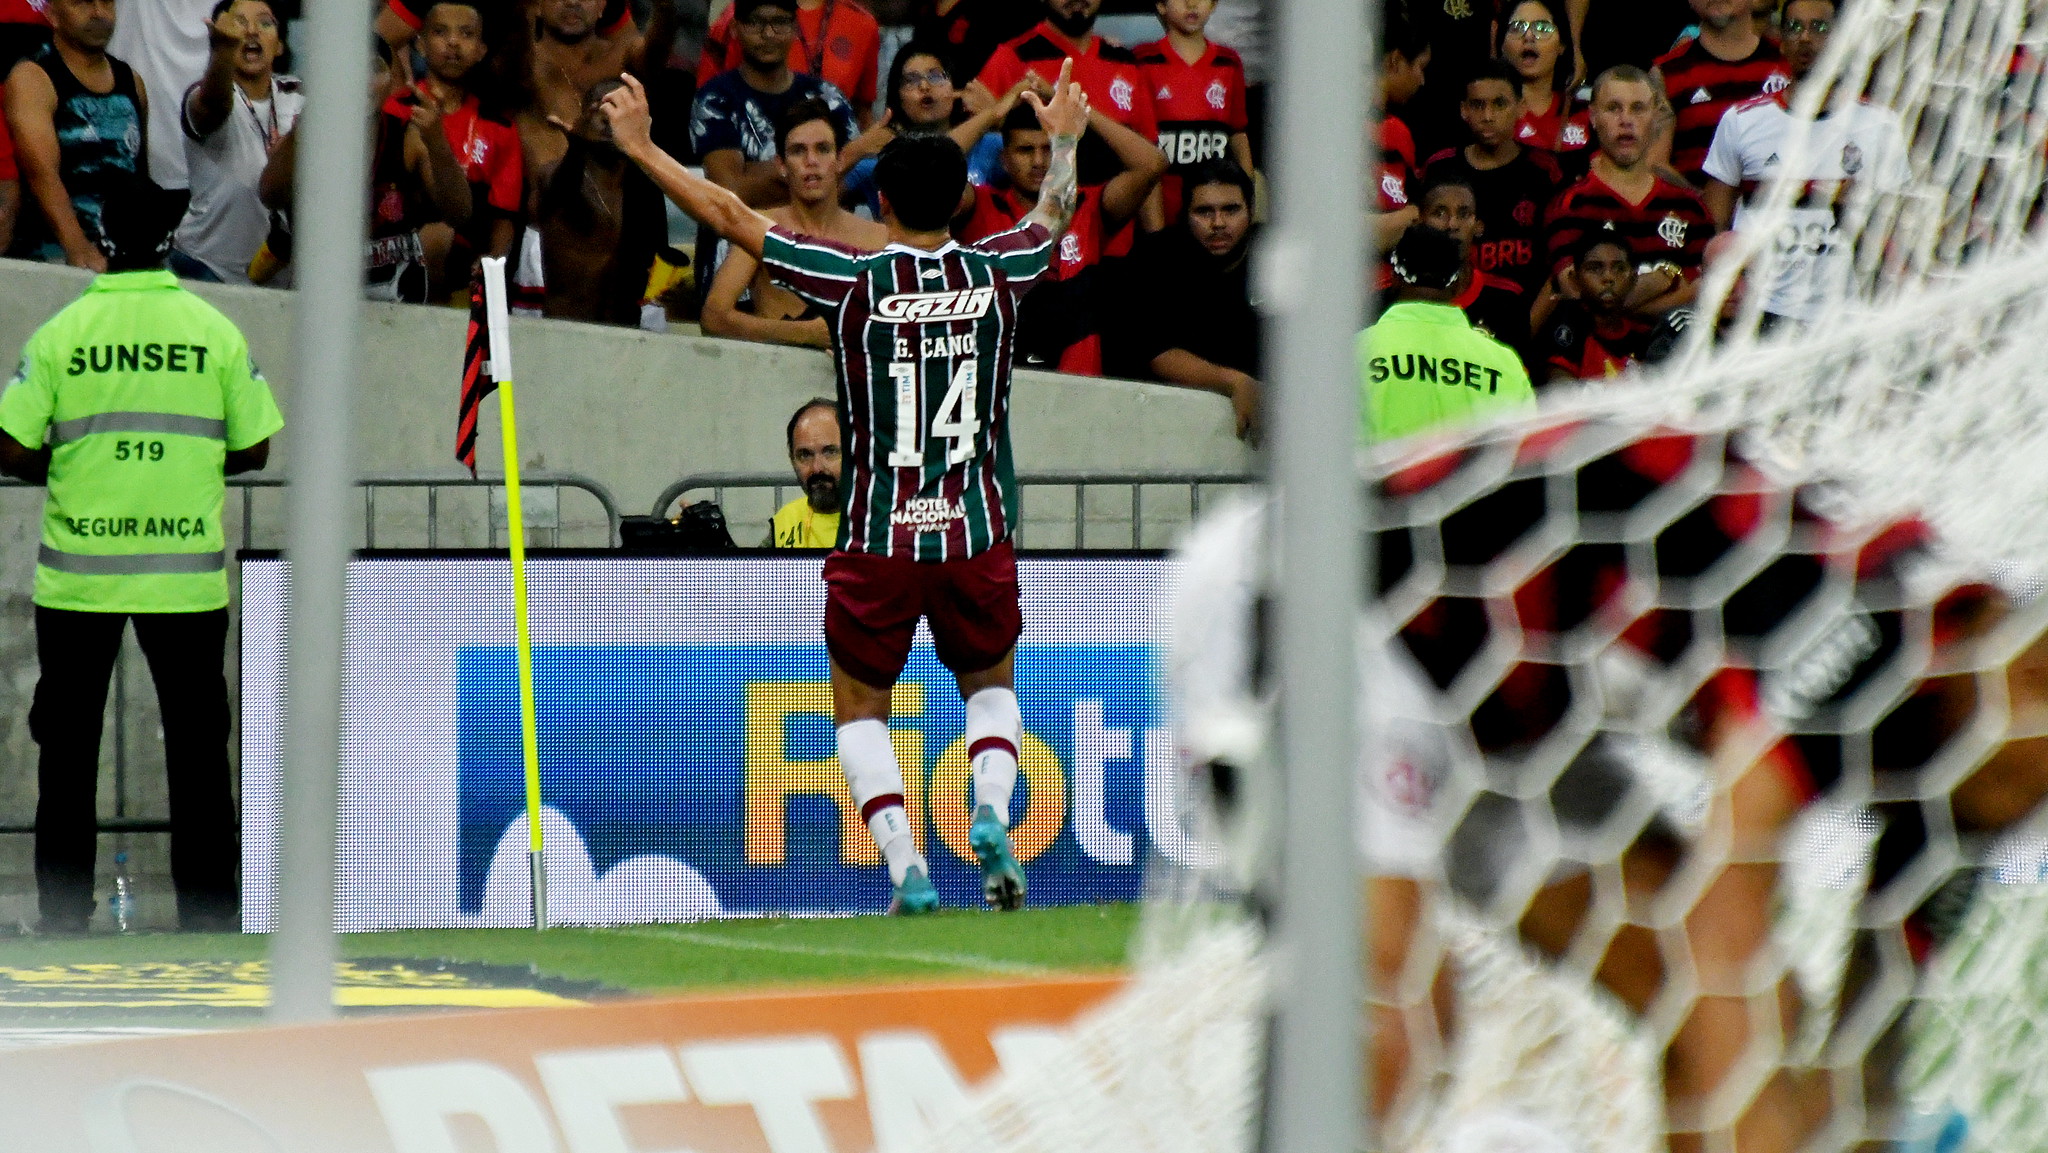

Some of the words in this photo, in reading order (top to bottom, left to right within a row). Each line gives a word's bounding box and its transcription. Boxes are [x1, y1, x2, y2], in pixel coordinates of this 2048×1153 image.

[1480, 240, 1533, 270] BRB
[868, 286, 995, 324] GAZIN
[66, 343, 209, 376] SUNSET
[895, 338, 914, 358] G.
[920, 333, 975, 358] CANO
[1368, 354, 1503, 395] SUNSET
[888, 360, 981, 467] 14
[115, 441, 164, 461] 519
[889, 504, 966, 525] NACIONAL
[905, 498, 950, 512] HOTEL
